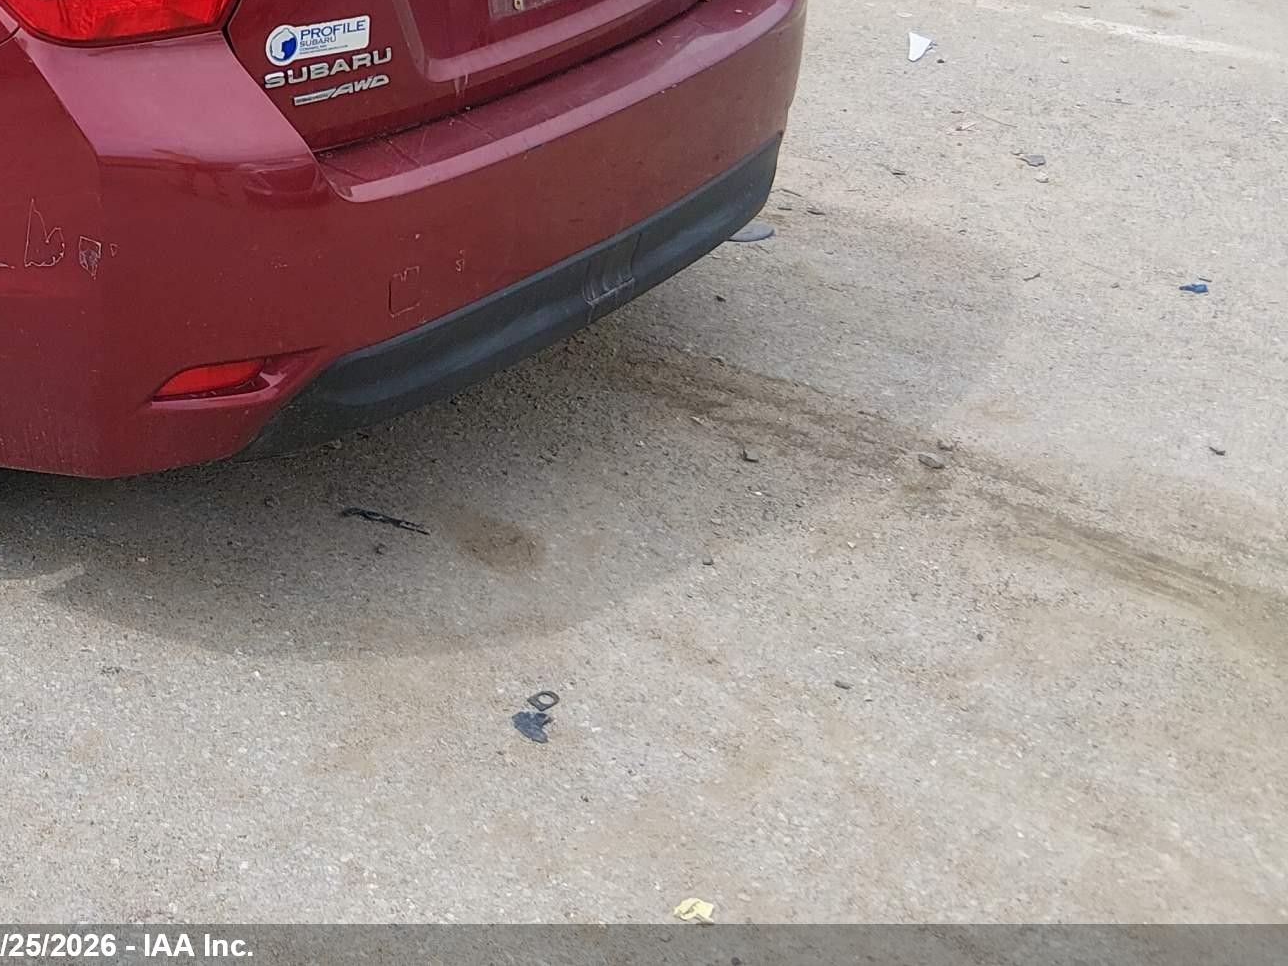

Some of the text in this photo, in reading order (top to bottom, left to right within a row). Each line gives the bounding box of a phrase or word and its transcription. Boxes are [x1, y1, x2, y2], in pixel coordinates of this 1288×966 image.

[299, 35, 337, 47] SUBARU
[300, 20, 366, 40] PROFILE
[264, 47, 392, 89] SUBARU
[331, 74, 390, 98] AWD
